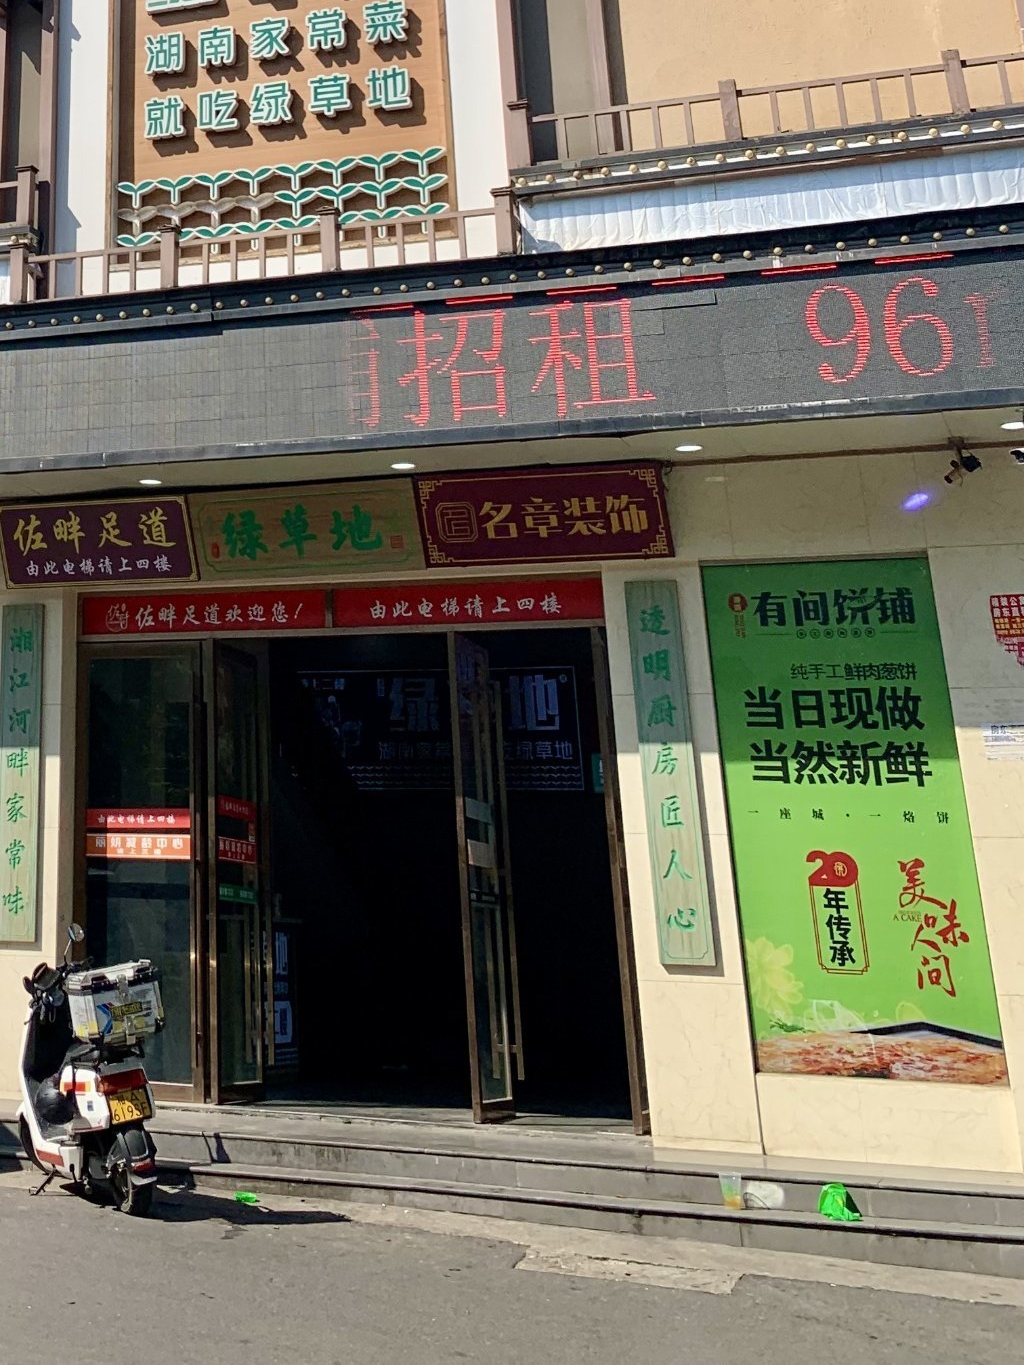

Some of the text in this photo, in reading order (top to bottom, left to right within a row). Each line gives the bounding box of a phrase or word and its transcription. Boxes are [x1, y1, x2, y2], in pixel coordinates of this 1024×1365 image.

[144, 66, 413, 140] 就吃绿草地
[14, 506, 176, 556] 佐畔足道
[221, 502, 384, 560] 绿草地
[478, 493, 650, 539] 名章装饰
[26, 555, 172, 577] 由此电梯请上四楼
[370, 592, 563, 618] 由此电梯请上四楼
[750, 587, 916, 627] 有间饼铺
[790, 662, 917, 680] 纯手工鲜肉葱饼
[743, 686, 925, 732] 当日现做
[2, 627, 34, 916] 湘江河畔家常味
[639, 604, 697, 931] 透明厨房匠人心
[749, 740, 933, 788] 当然新鲜
[806, 850, 859, 887] 20
[823, 888, 856, 967] 年传承
